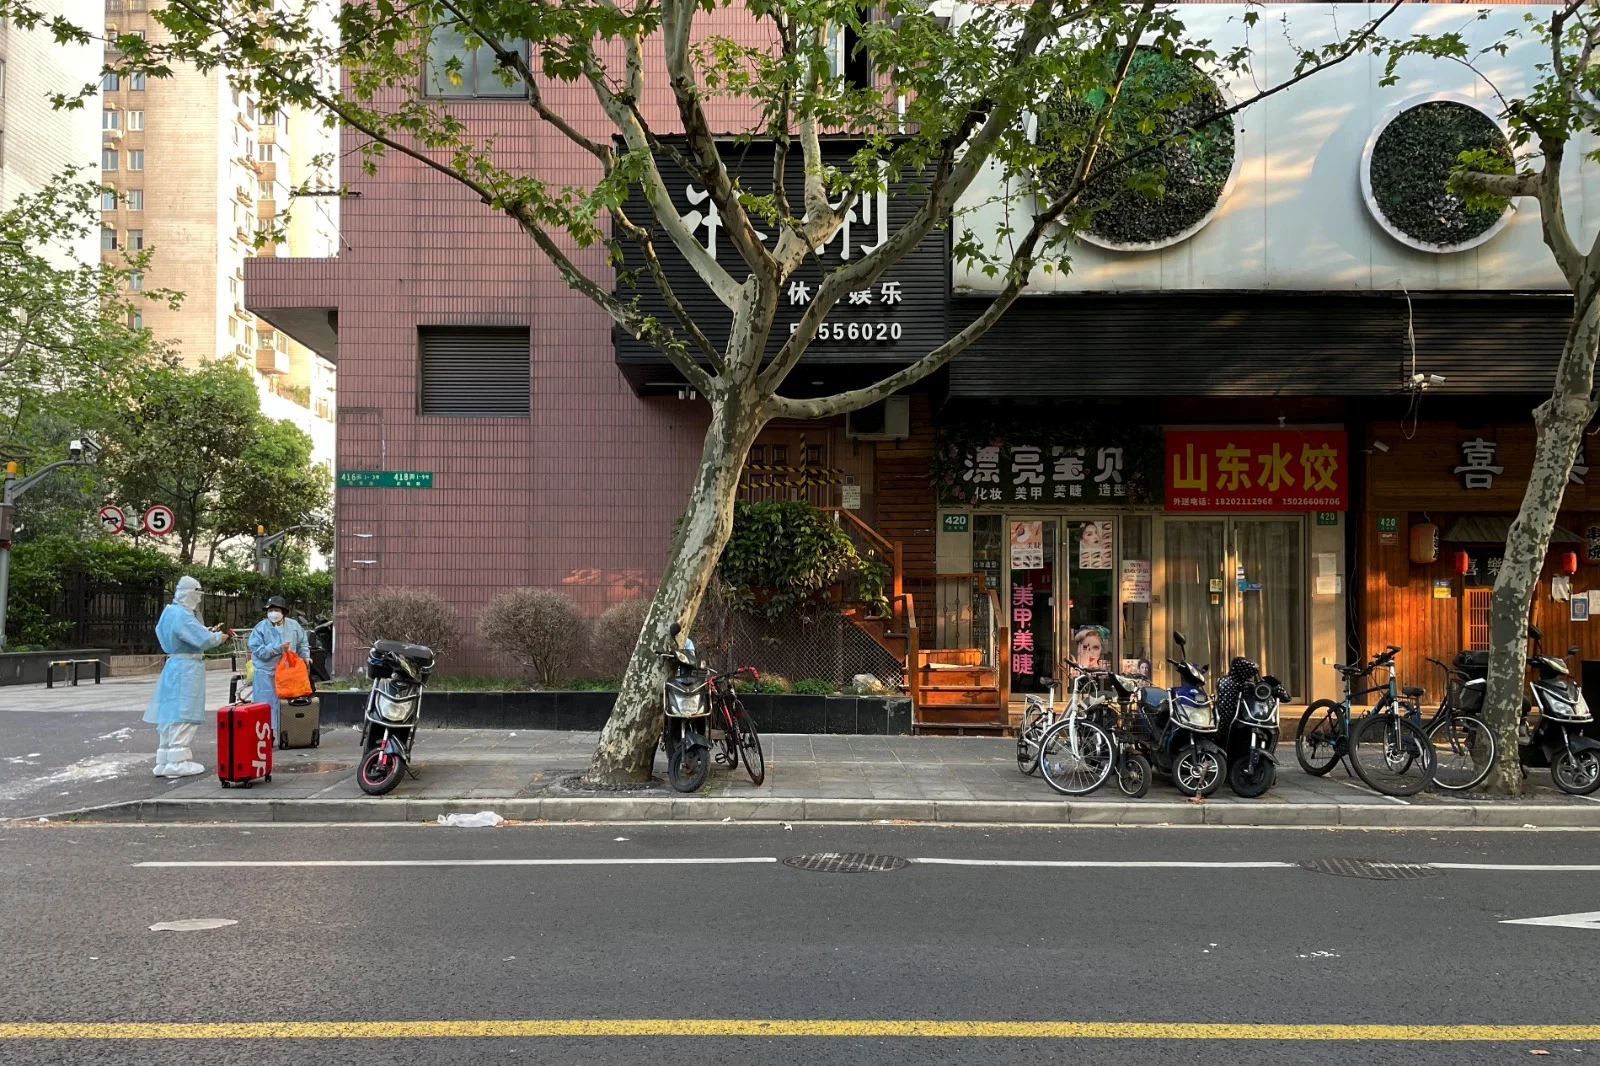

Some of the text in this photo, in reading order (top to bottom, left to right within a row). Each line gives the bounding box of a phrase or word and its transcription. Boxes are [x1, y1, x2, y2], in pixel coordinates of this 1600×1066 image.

[787, 281, 903, 305] 休娱乐
[789, 323, 902, 340] 5556020
[963, 445, 1124, 485] 漂亮宝贝
[1173, 442, 1338, 492] 山东水饺
[974, 484, 1126, 501] 化妆 美甲 美睫 造型
[152, 511, 166, 529] 5
[945, 515, 967, 525] 420
[1319, 512, 1335, 521] 420
[1380, 518, 1396, 527] 420
[1012, 582, 1034, 675] 美甲美睫
